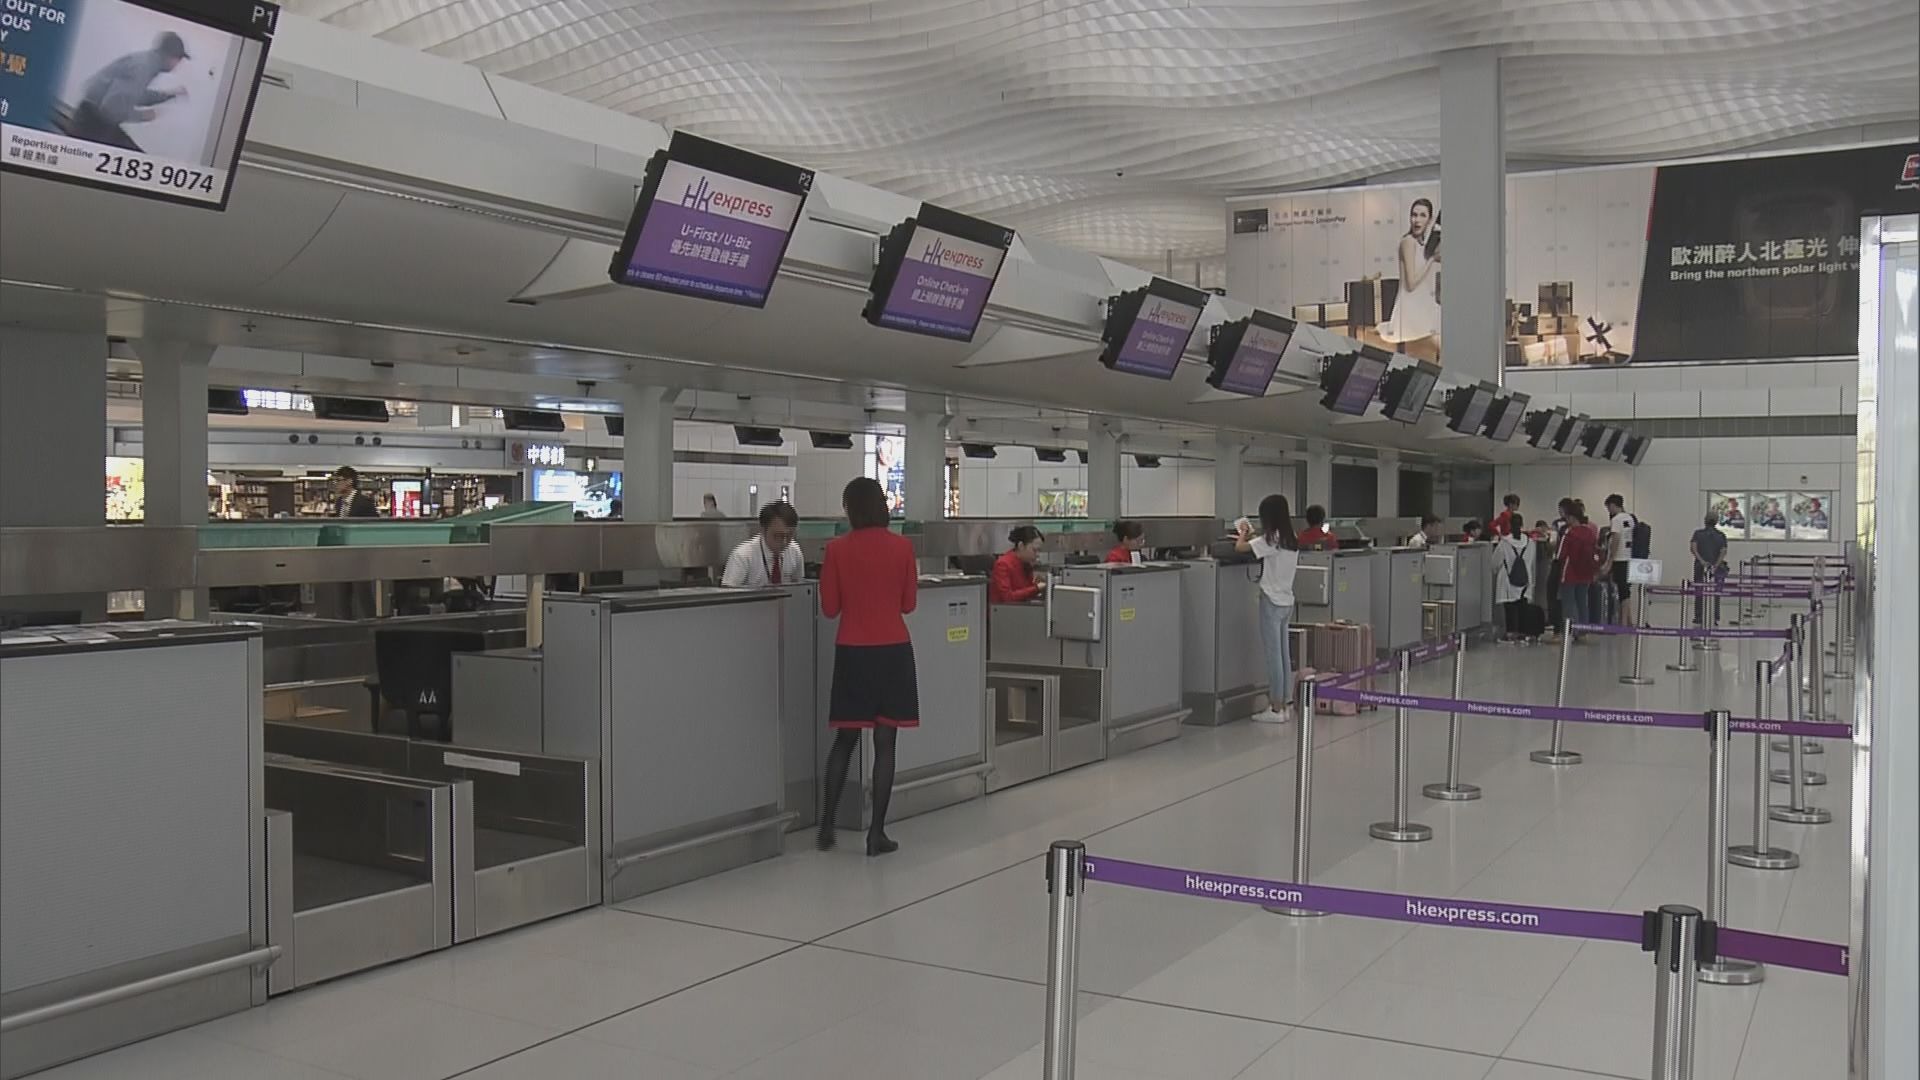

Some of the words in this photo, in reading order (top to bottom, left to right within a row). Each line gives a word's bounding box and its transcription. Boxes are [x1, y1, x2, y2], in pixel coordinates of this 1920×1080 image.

[39, 6, 66, 24] FOR
[251, 6, 275, 28] P1
[12, 134, 59, 153] Reporting
[60, 144, 94, 159] Hotline
[96, 152, 154, 181] 2183
[159, 165, 214, 194] 9074
[1670, 268, 1702, 281] Bring
[1705, 268, 1725, 279] the
[1727, 264, 1780, 278] northern
[1783, 262, 1815, 276] polar
[1818, 261, 1847, 274] light
[1467, 703, 1531, 716] hkexpress.com
[1584, 711, 1654, 724] hkexpress.com
[1185, 874, 1303, 904] hkexpress.com
[1406, 900, 1540, 928] hkexpress.com
